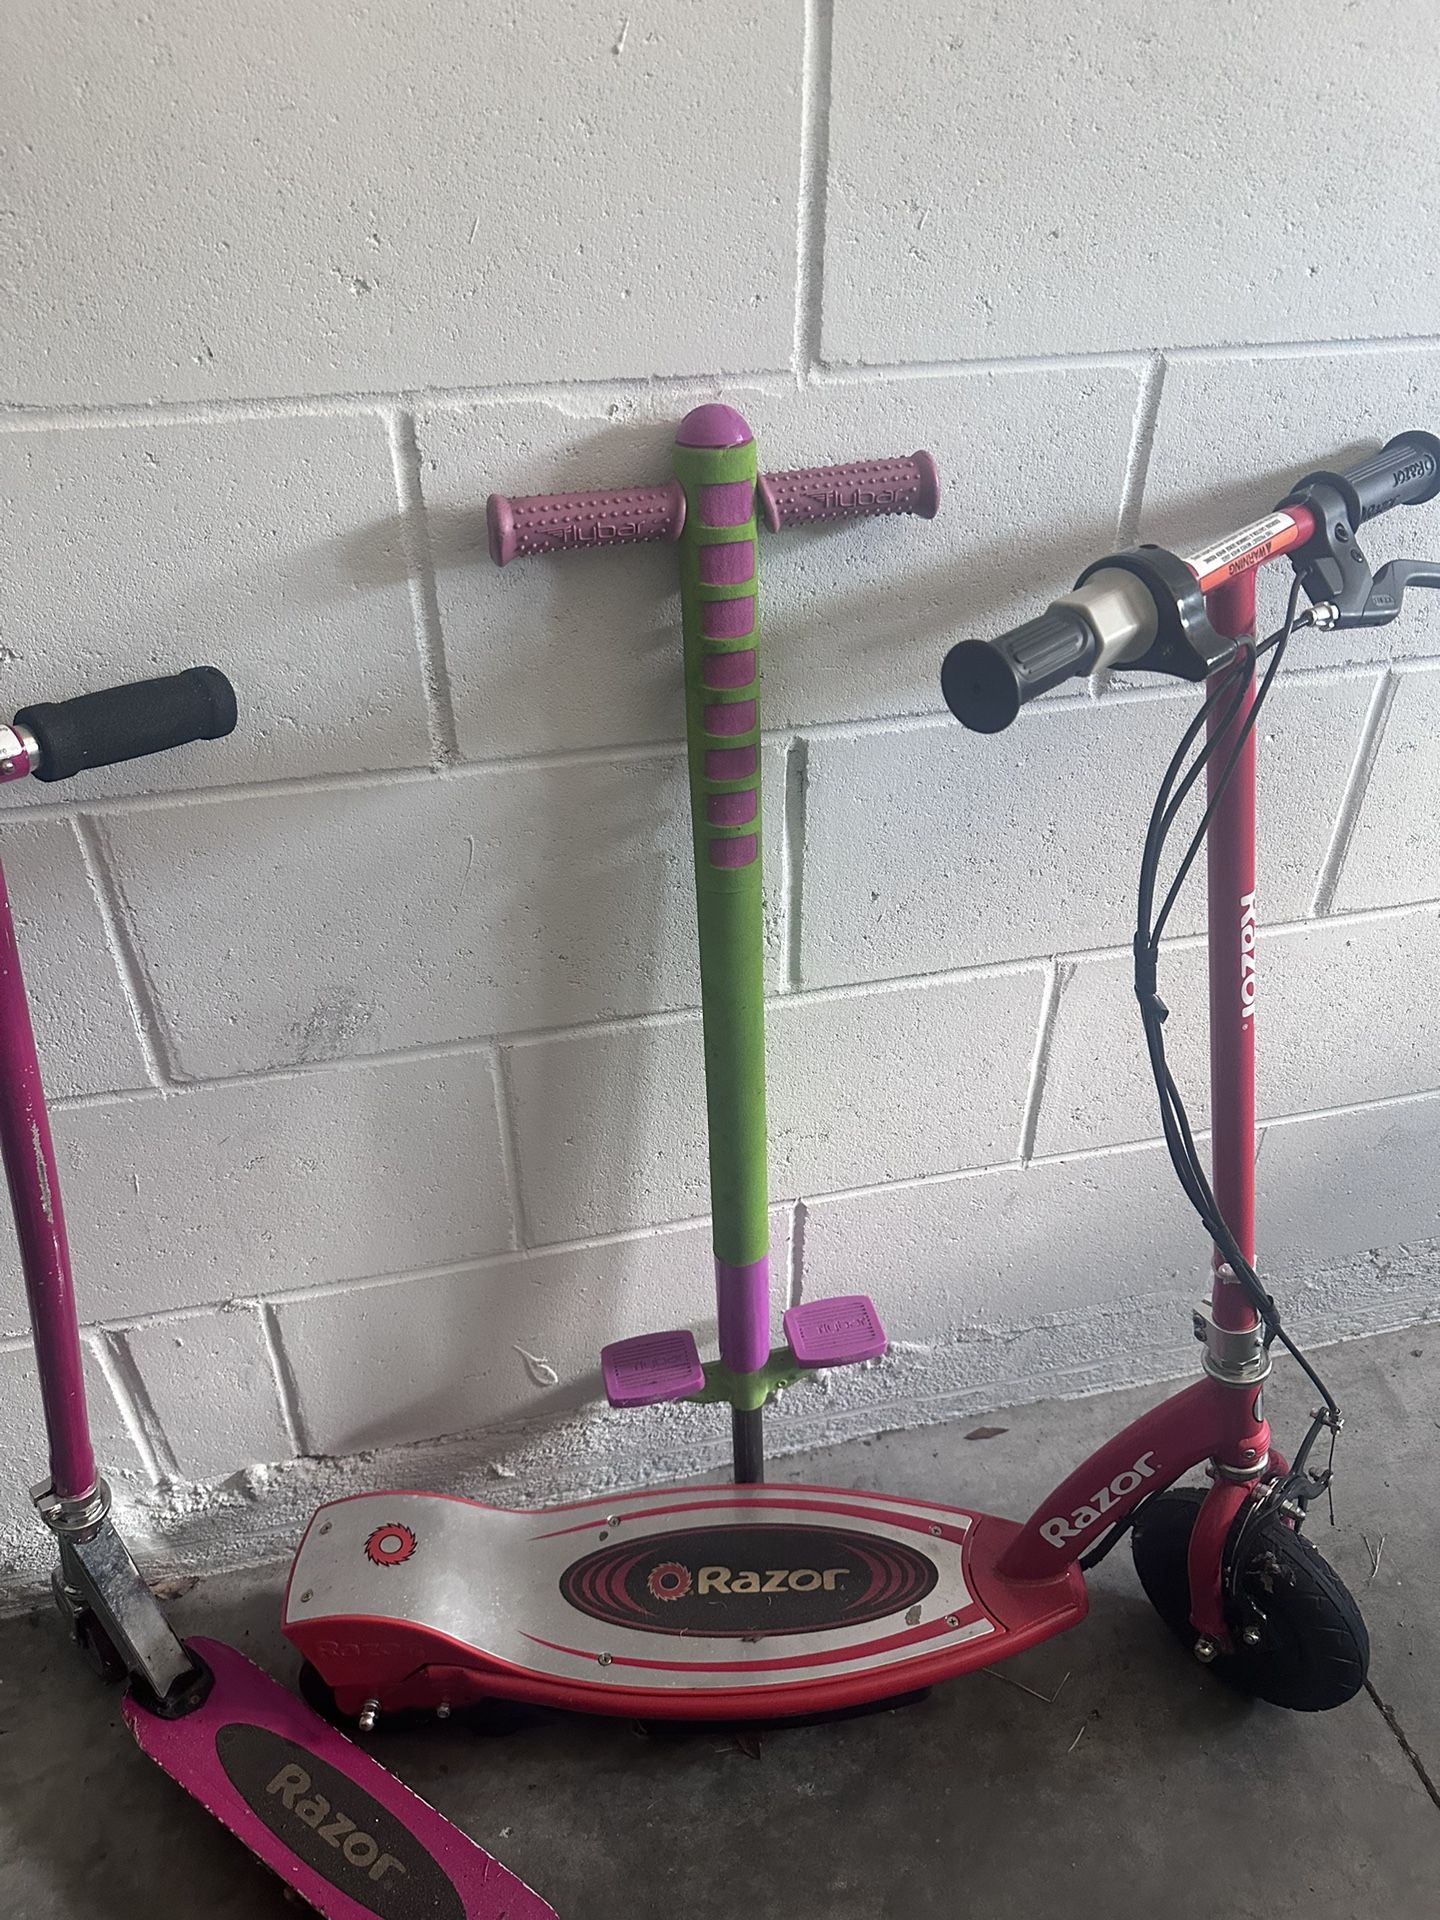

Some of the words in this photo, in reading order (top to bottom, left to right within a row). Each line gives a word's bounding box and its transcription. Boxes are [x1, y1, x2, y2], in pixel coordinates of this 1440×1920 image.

[800, 487, 903, 509] flybar
[537, 520, 646, 543] flybar
[1229, 543, 1268, 576] WARNING
[1038, 1450, 1158, 1550] Razor
[692, 1565, 851, 1596] Razor
[264, 1762, 407, 1881] Razor
